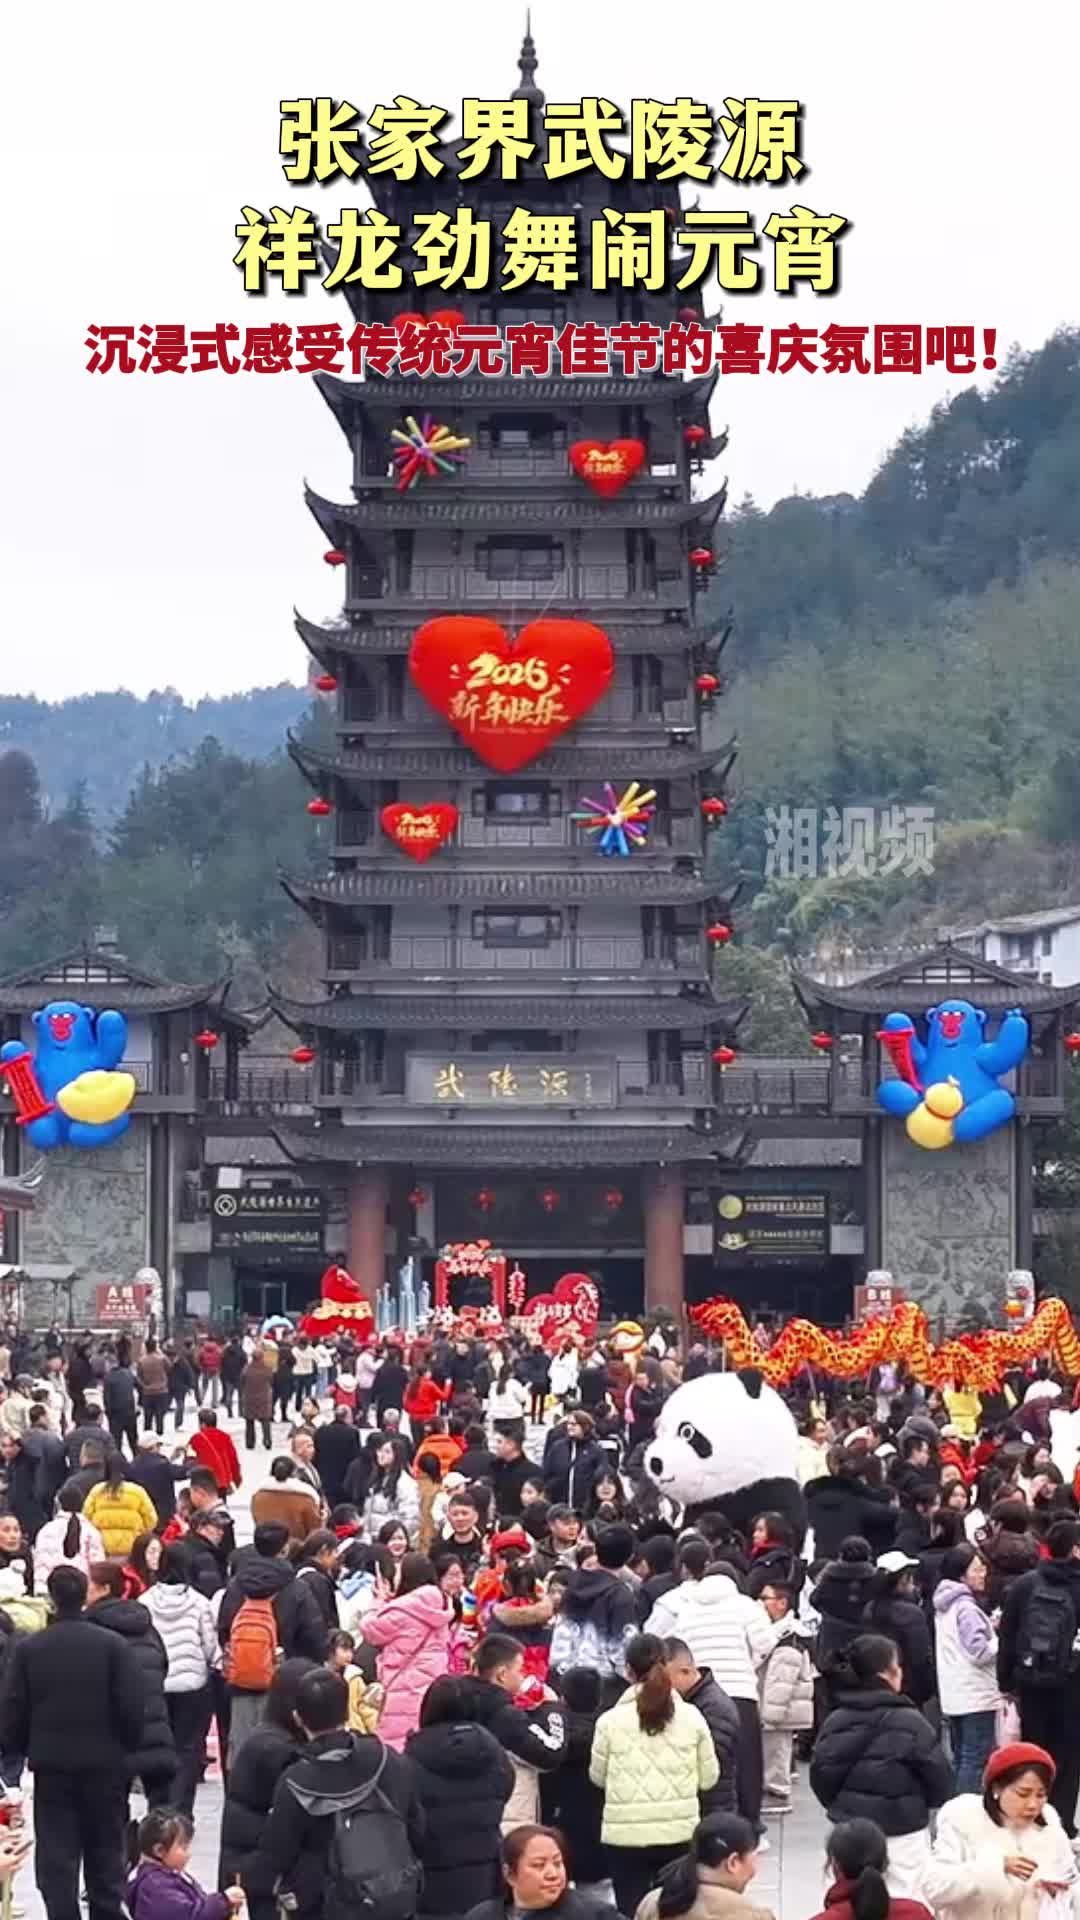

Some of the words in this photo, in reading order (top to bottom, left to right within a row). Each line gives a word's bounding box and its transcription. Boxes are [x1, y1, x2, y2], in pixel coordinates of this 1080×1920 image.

[466, 652, 548, 690] 2026
[449, 684, 569, 733] 新年快乐
[433, 1063, 568, 1098] 武陵源
